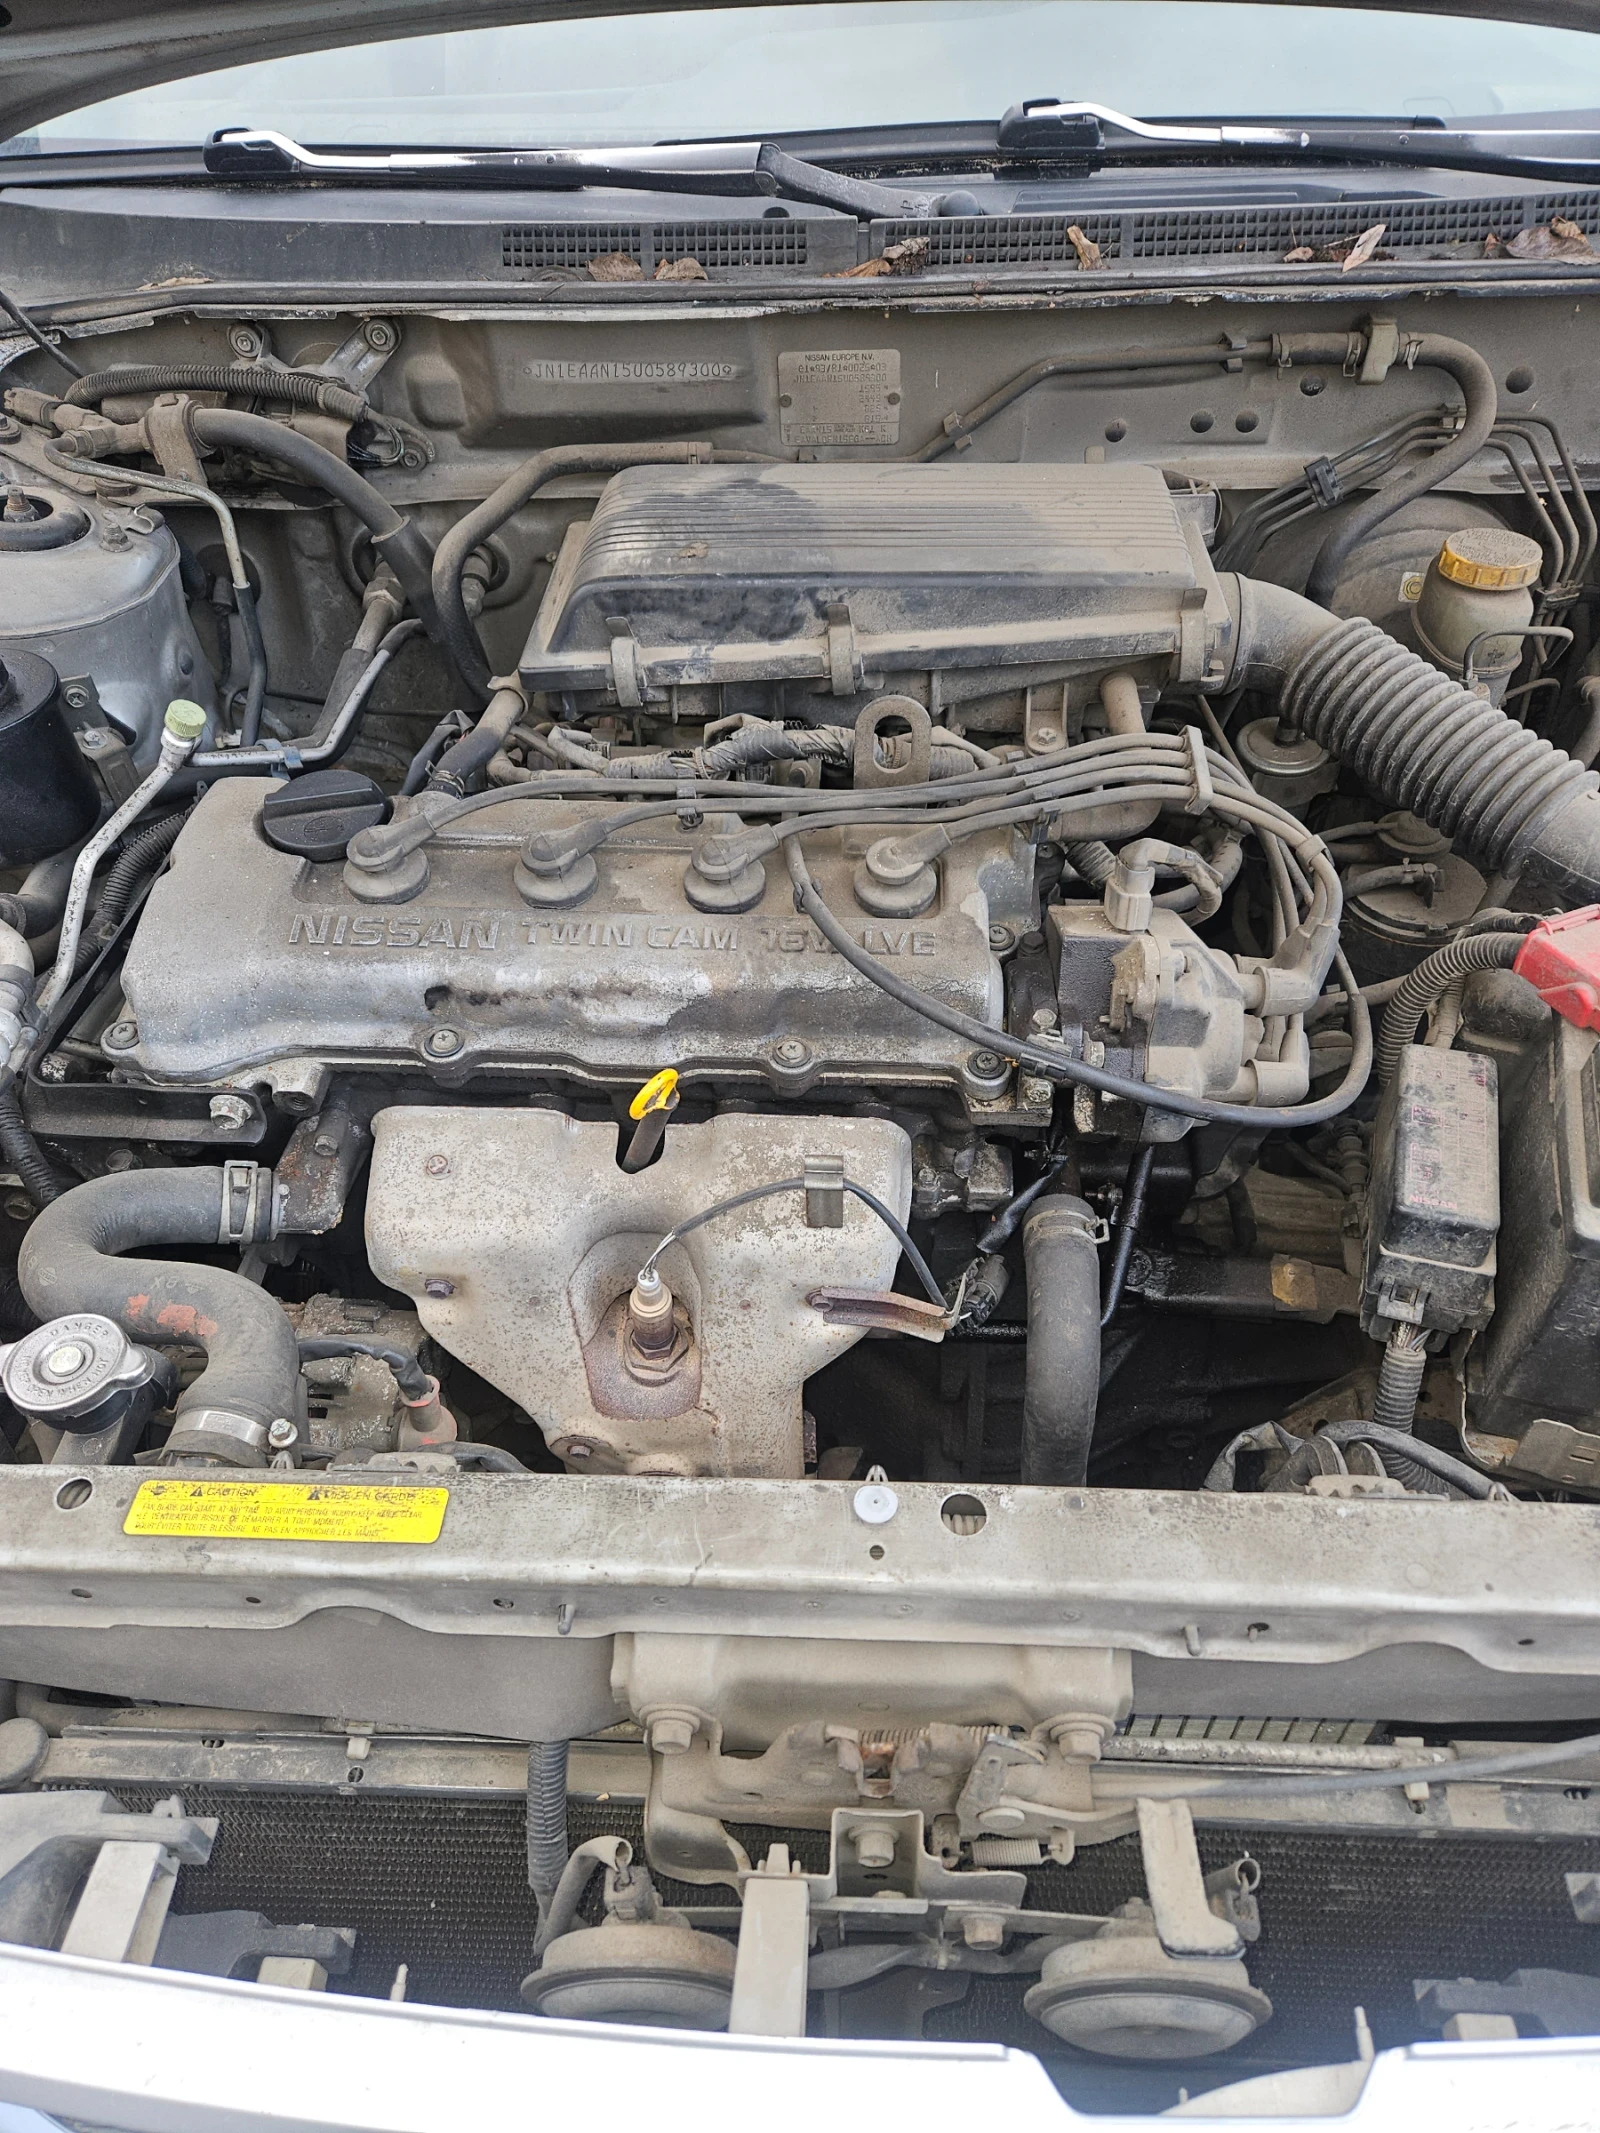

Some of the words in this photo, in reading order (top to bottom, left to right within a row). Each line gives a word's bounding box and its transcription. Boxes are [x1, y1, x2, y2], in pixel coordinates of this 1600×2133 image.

[832, 353, 860, 361] EUROPE
[861, 353, 875, 361] N.V.
[535, 362, 722, 379] JN1EAAN15U0589300
[289, 913, 500, 950] NISSAN
[521, 920, 632, 948] TWIN
[647, 923, 739, 951] CAM
[1409, 1194, 1458, 1209] NISSAN
[49, 1321, 110, 1337] DANGER
[92, 1357, 109, 1377] HOT
[206, 1487, 259, 1497] CAUTION
[179, 1503, 194, 1512] CAN
[195, 1504, 215, 1513] START
[201, 1513, 226, 1522] RISQUE
[185, 1523, 207, 1531] TOUTE
[264, 1525, 278, 1534] PAS
